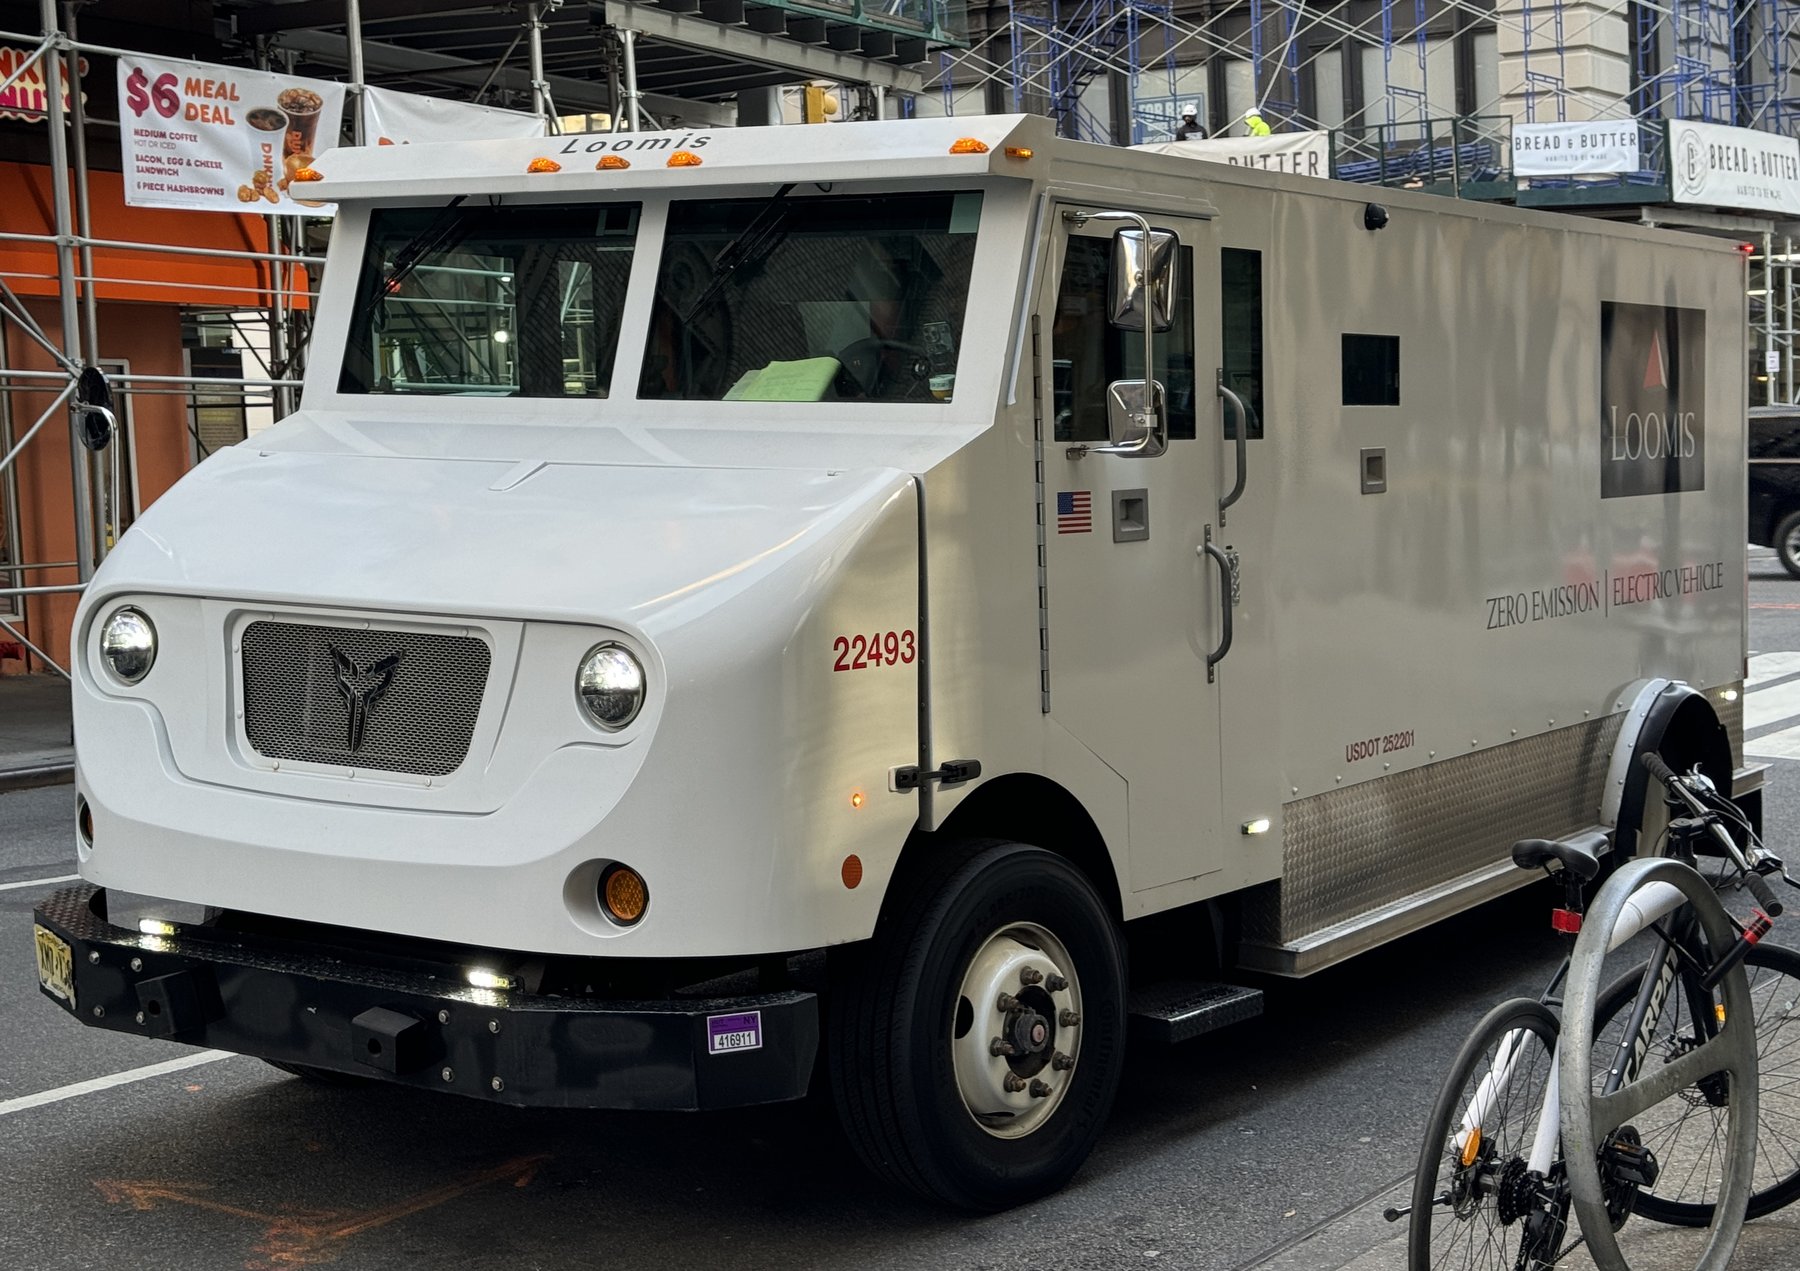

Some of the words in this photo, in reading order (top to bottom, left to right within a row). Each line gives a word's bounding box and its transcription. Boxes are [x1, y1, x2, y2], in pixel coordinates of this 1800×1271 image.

[127, 67, 180, 118] $6
[184, 77, 240, 102] MEAL
[184, 102, 235, 125] DEAL
[133, 128, 167, 139] MEDIUM
[169, 132, 198, 143] COFFEE
[134, 139, 147, 147] HOT
[148, 140, 159, 149] OR
[160, 141, 176, 150] ICED
[559, 132, 712, 155] Loomis
[1515, 135, 1561, 151] BREAD
[1580, 132, 1637, 148] BUTTER
[135, 154, 165, 165] BACON,
[167, 157, 184, 166] EGG
[186, 159, 192, 167] &
[194, 159, 223, 170] CHEESE
[136, 165, 179, 176] SANDWICH
[1709, 144, 1748, 172] BREAD
[1760, 151, 1799, 181] BUTTER
[142, 182, 165, 191] PIECE
[166, 184, 225, 196] HASHBROWNS
[1610, 405, 1696, 461] LOOMIS
[1486, 592, 1528, 630] ZERO
[1532, 580, 1600, 622] EMISSION
[1613, 569, 1672, 607] ELECTRIC
[1674, 562, 1724, 596] VEHICLE
[833, 629, 916, 672] 22493
[1345, 737, 1381, 763] USDOT
[1382, 729, 1415, 754] 252201
[743, 1015, 756, 1025] NY
[718, 1032, 752, 1048] 416911
